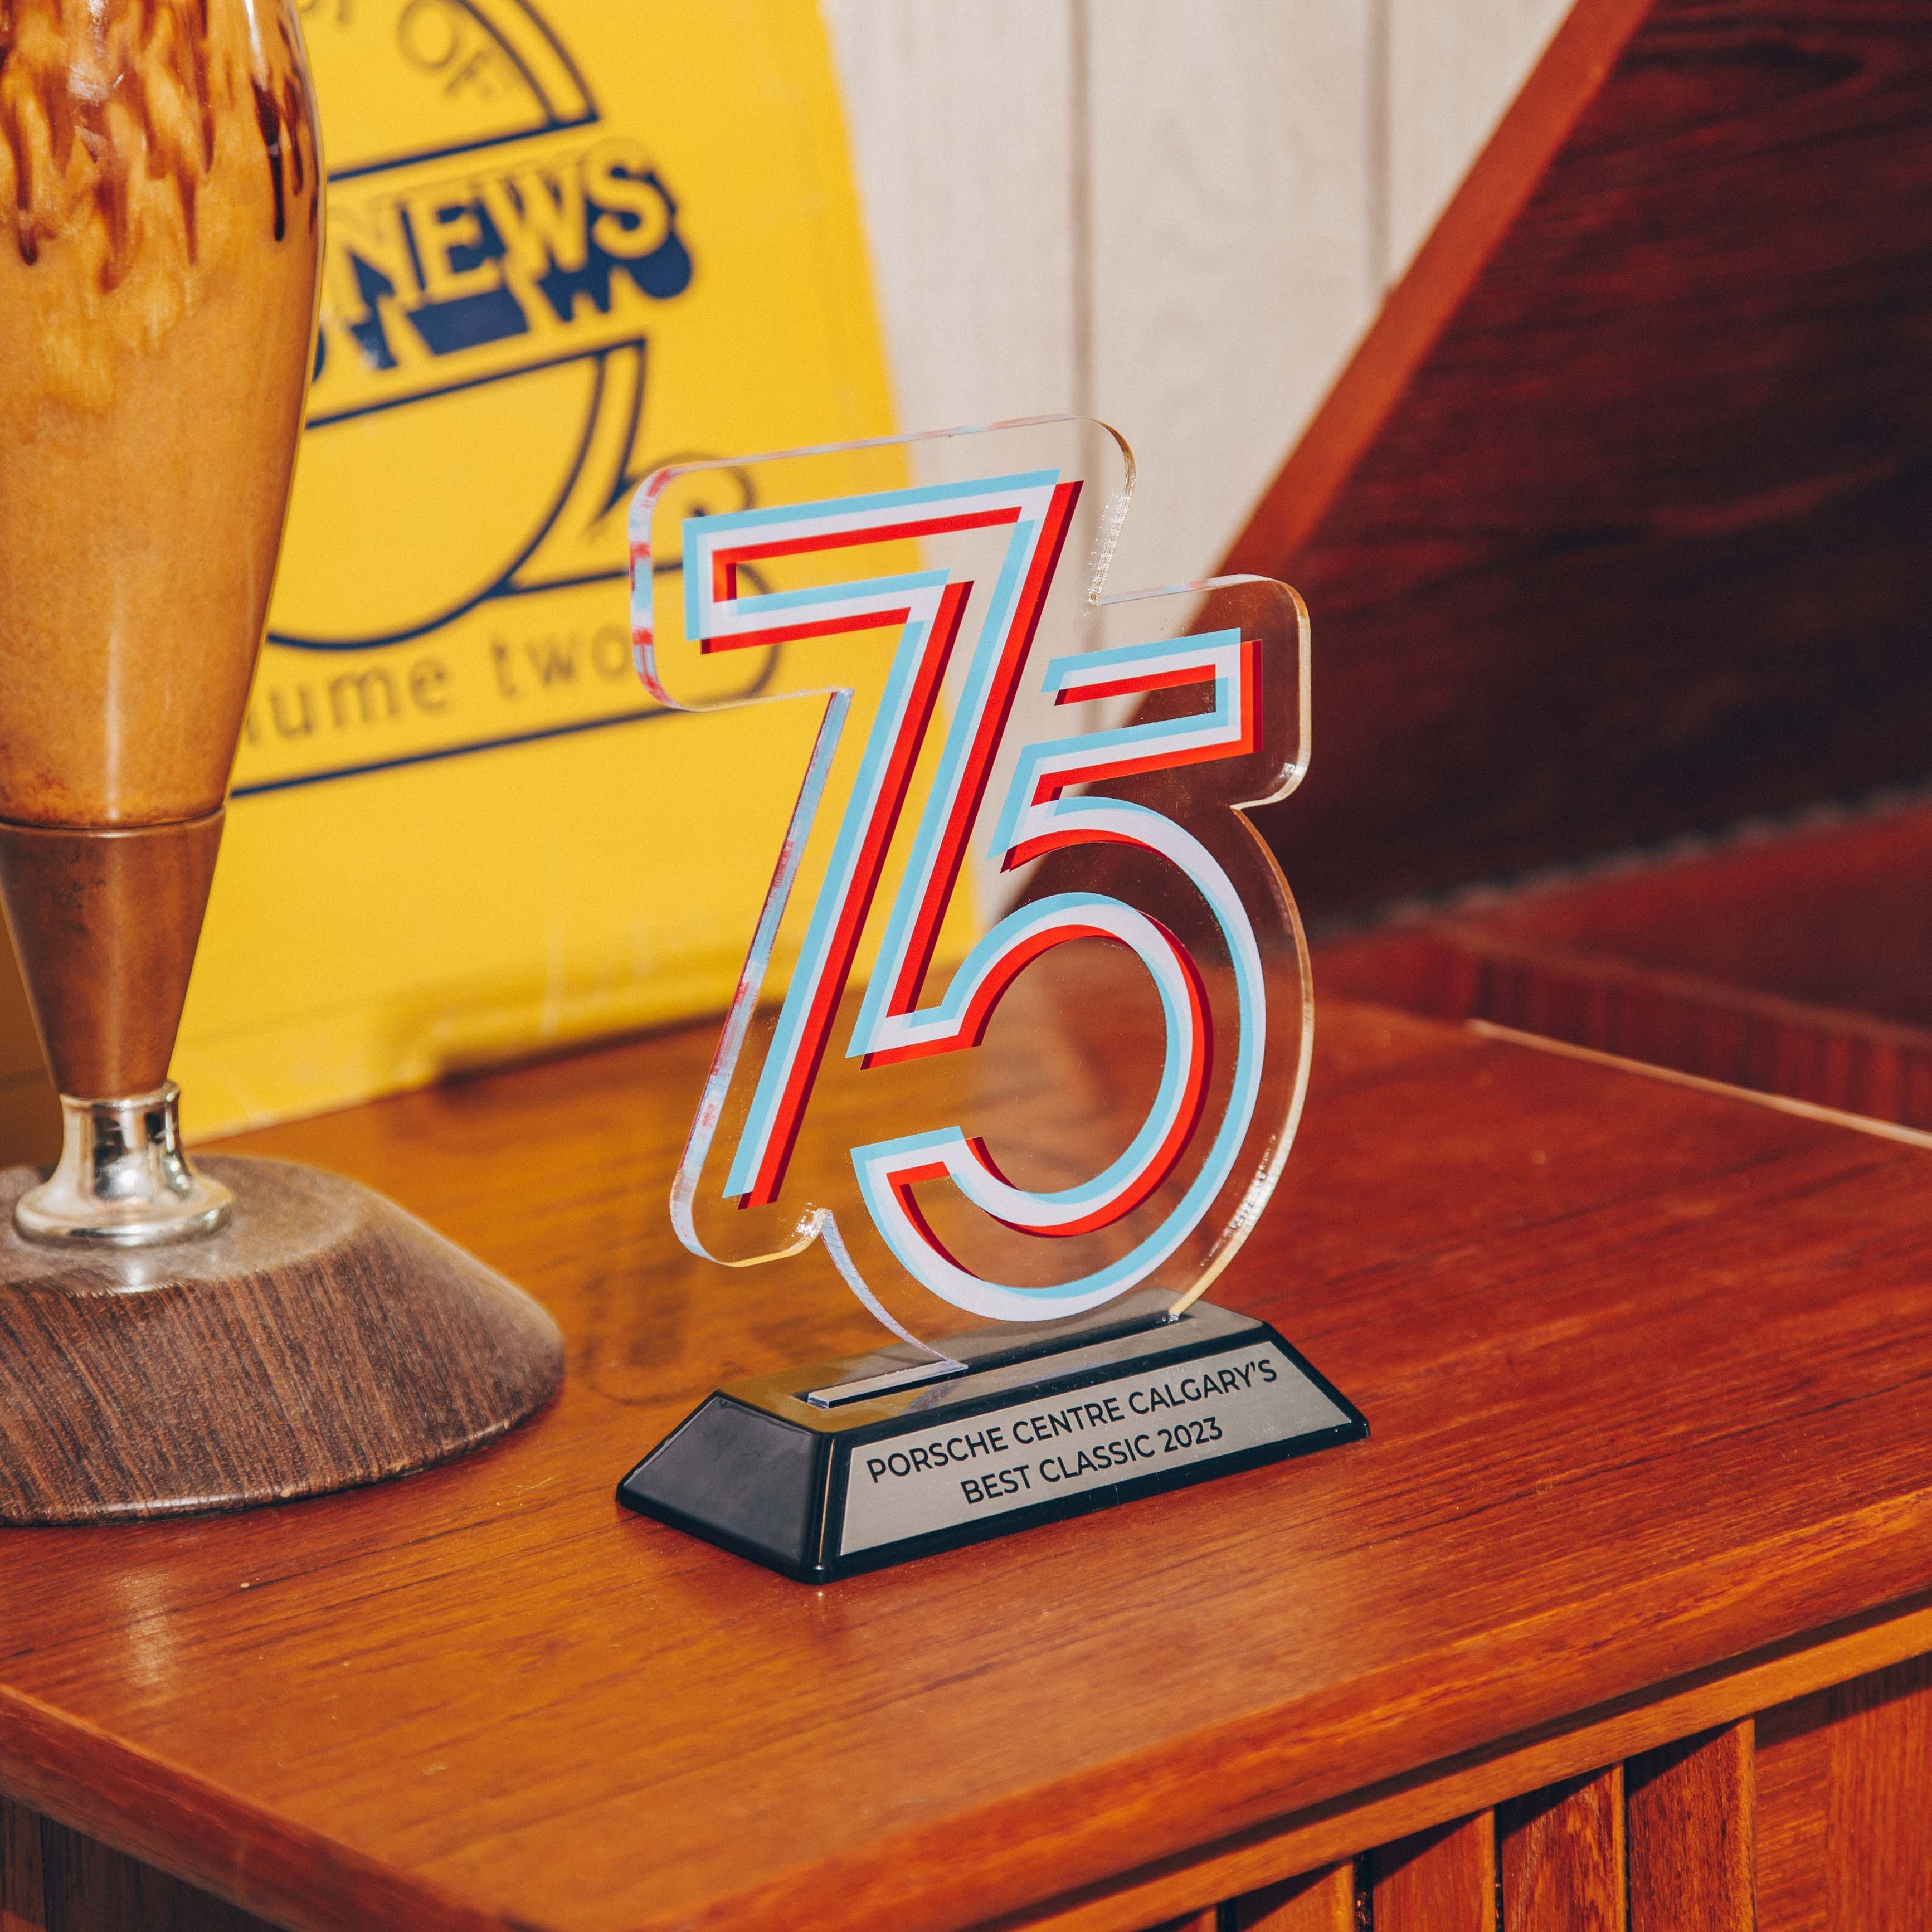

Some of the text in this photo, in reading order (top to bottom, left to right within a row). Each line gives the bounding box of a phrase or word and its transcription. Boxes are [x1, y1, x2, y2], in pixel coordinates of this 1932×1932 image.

[490, 621, 633, 701] two
[683, 469, 1267, 1321] 75
[866, 1359, 1277, 1483] PORSCHE CENTRE CALGARY'S
[960, 1416, 1223, 1505] BEST CLASSIC 2023
